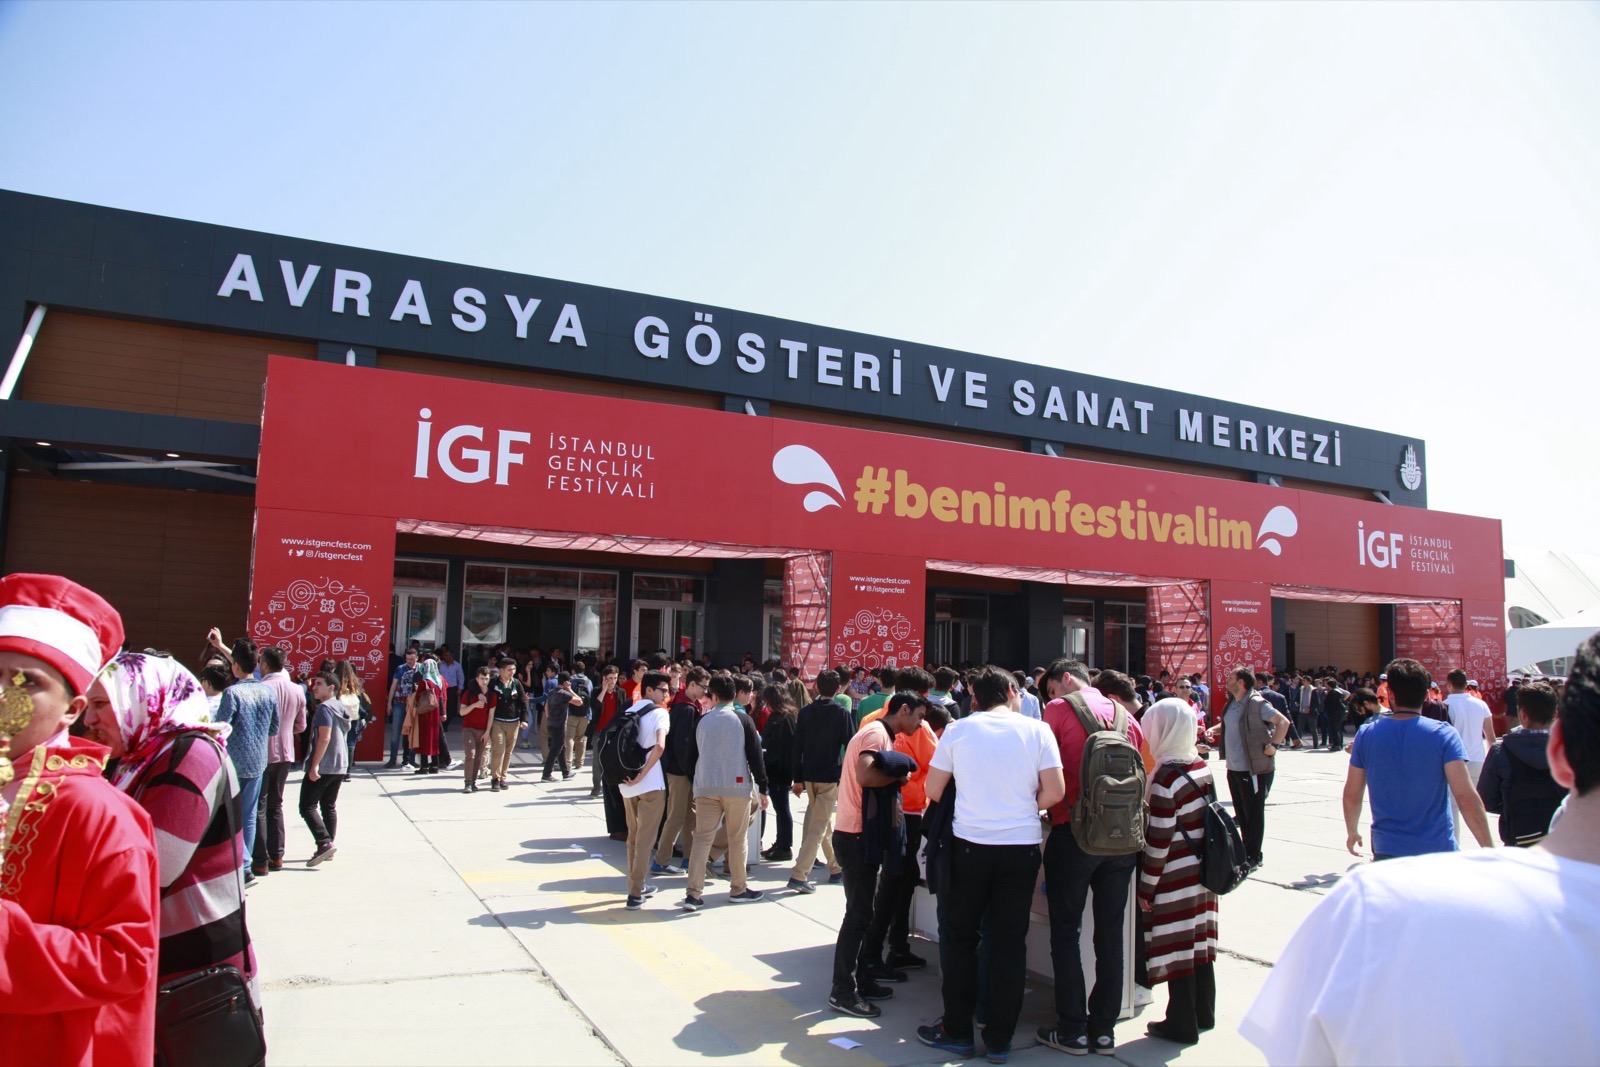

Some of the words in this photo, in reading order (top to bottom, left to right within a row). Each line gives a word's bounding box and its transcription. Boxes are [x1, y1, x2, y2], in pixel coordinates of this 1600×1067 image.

[217, 253, 589, 348] AVRASYA
[633, 312, 903, 396] GÖSTERİ
[928, 363, 989, 410] VE
[1012, 378, 1155, 436] SANAT
[1178, 407, 1342, 468] MERKEZİ
[413, 407, 532, 486] İGF
[549, 432, 655, 460] İSTANBUL
[548, 455, 643, 479] GENÇLİK
[547, 475, 654, 499] FESTİVALİ
[853, 465, 1253, 550] #benimfestivalim
[281, 538, 372, 550] www.istgencfest.com
[1357, 520, 1404, 569] İGF
[1409, 534, 1453, 550] İSTANBUL
[1410, 548, 1449, 562] GENÇLİK
[1411, 560, 1455, 575] FESTİVALİ
[849, 575, 911, 585] www.istgencfest.com
